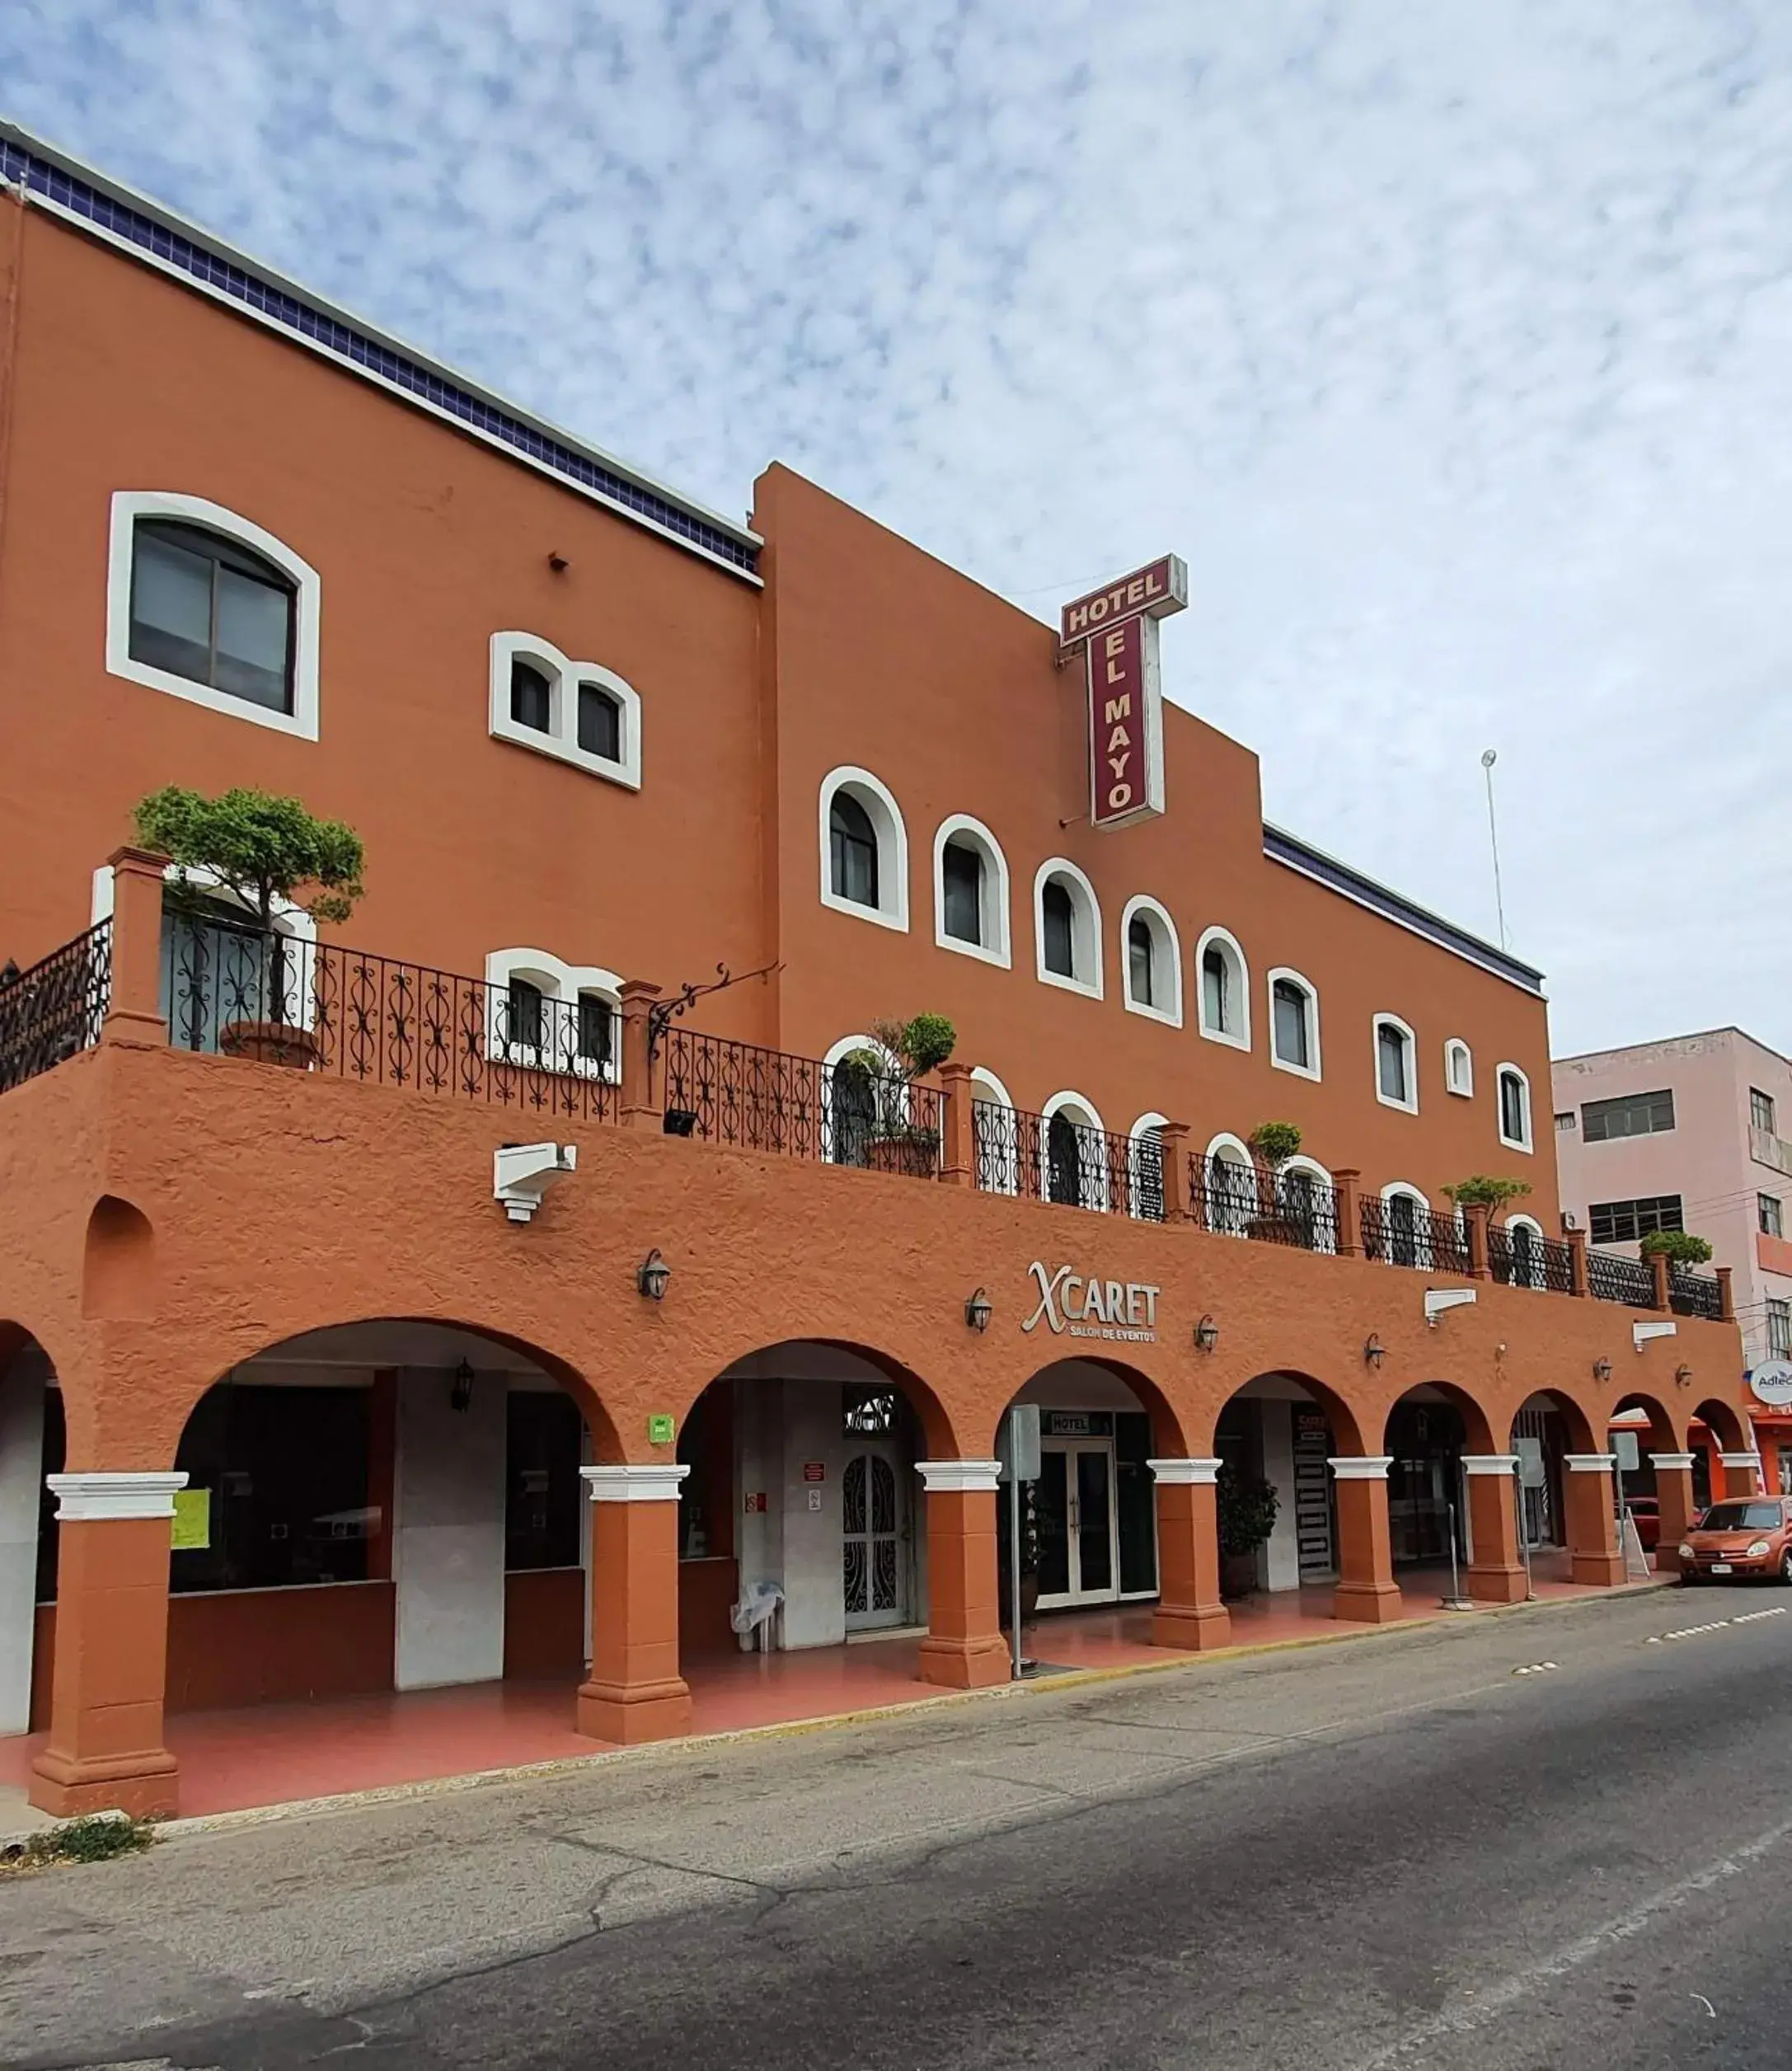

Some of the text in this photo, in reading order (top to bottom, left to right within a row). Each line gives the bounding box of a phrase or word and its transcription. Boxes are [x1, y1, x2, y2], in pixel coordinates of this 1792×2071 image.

[1069, 573, 1162, 634] HOTEL
[1105, 628, 1132, 809] EL MAYO
[1020, 1261, 1161, 1333] XCARET
[1102, 1328, 1115, 1340] DE
[1116, 1329, 1156, 1342] EVENTOS
[1054, 1416, 1087, 1430] HOTEL
